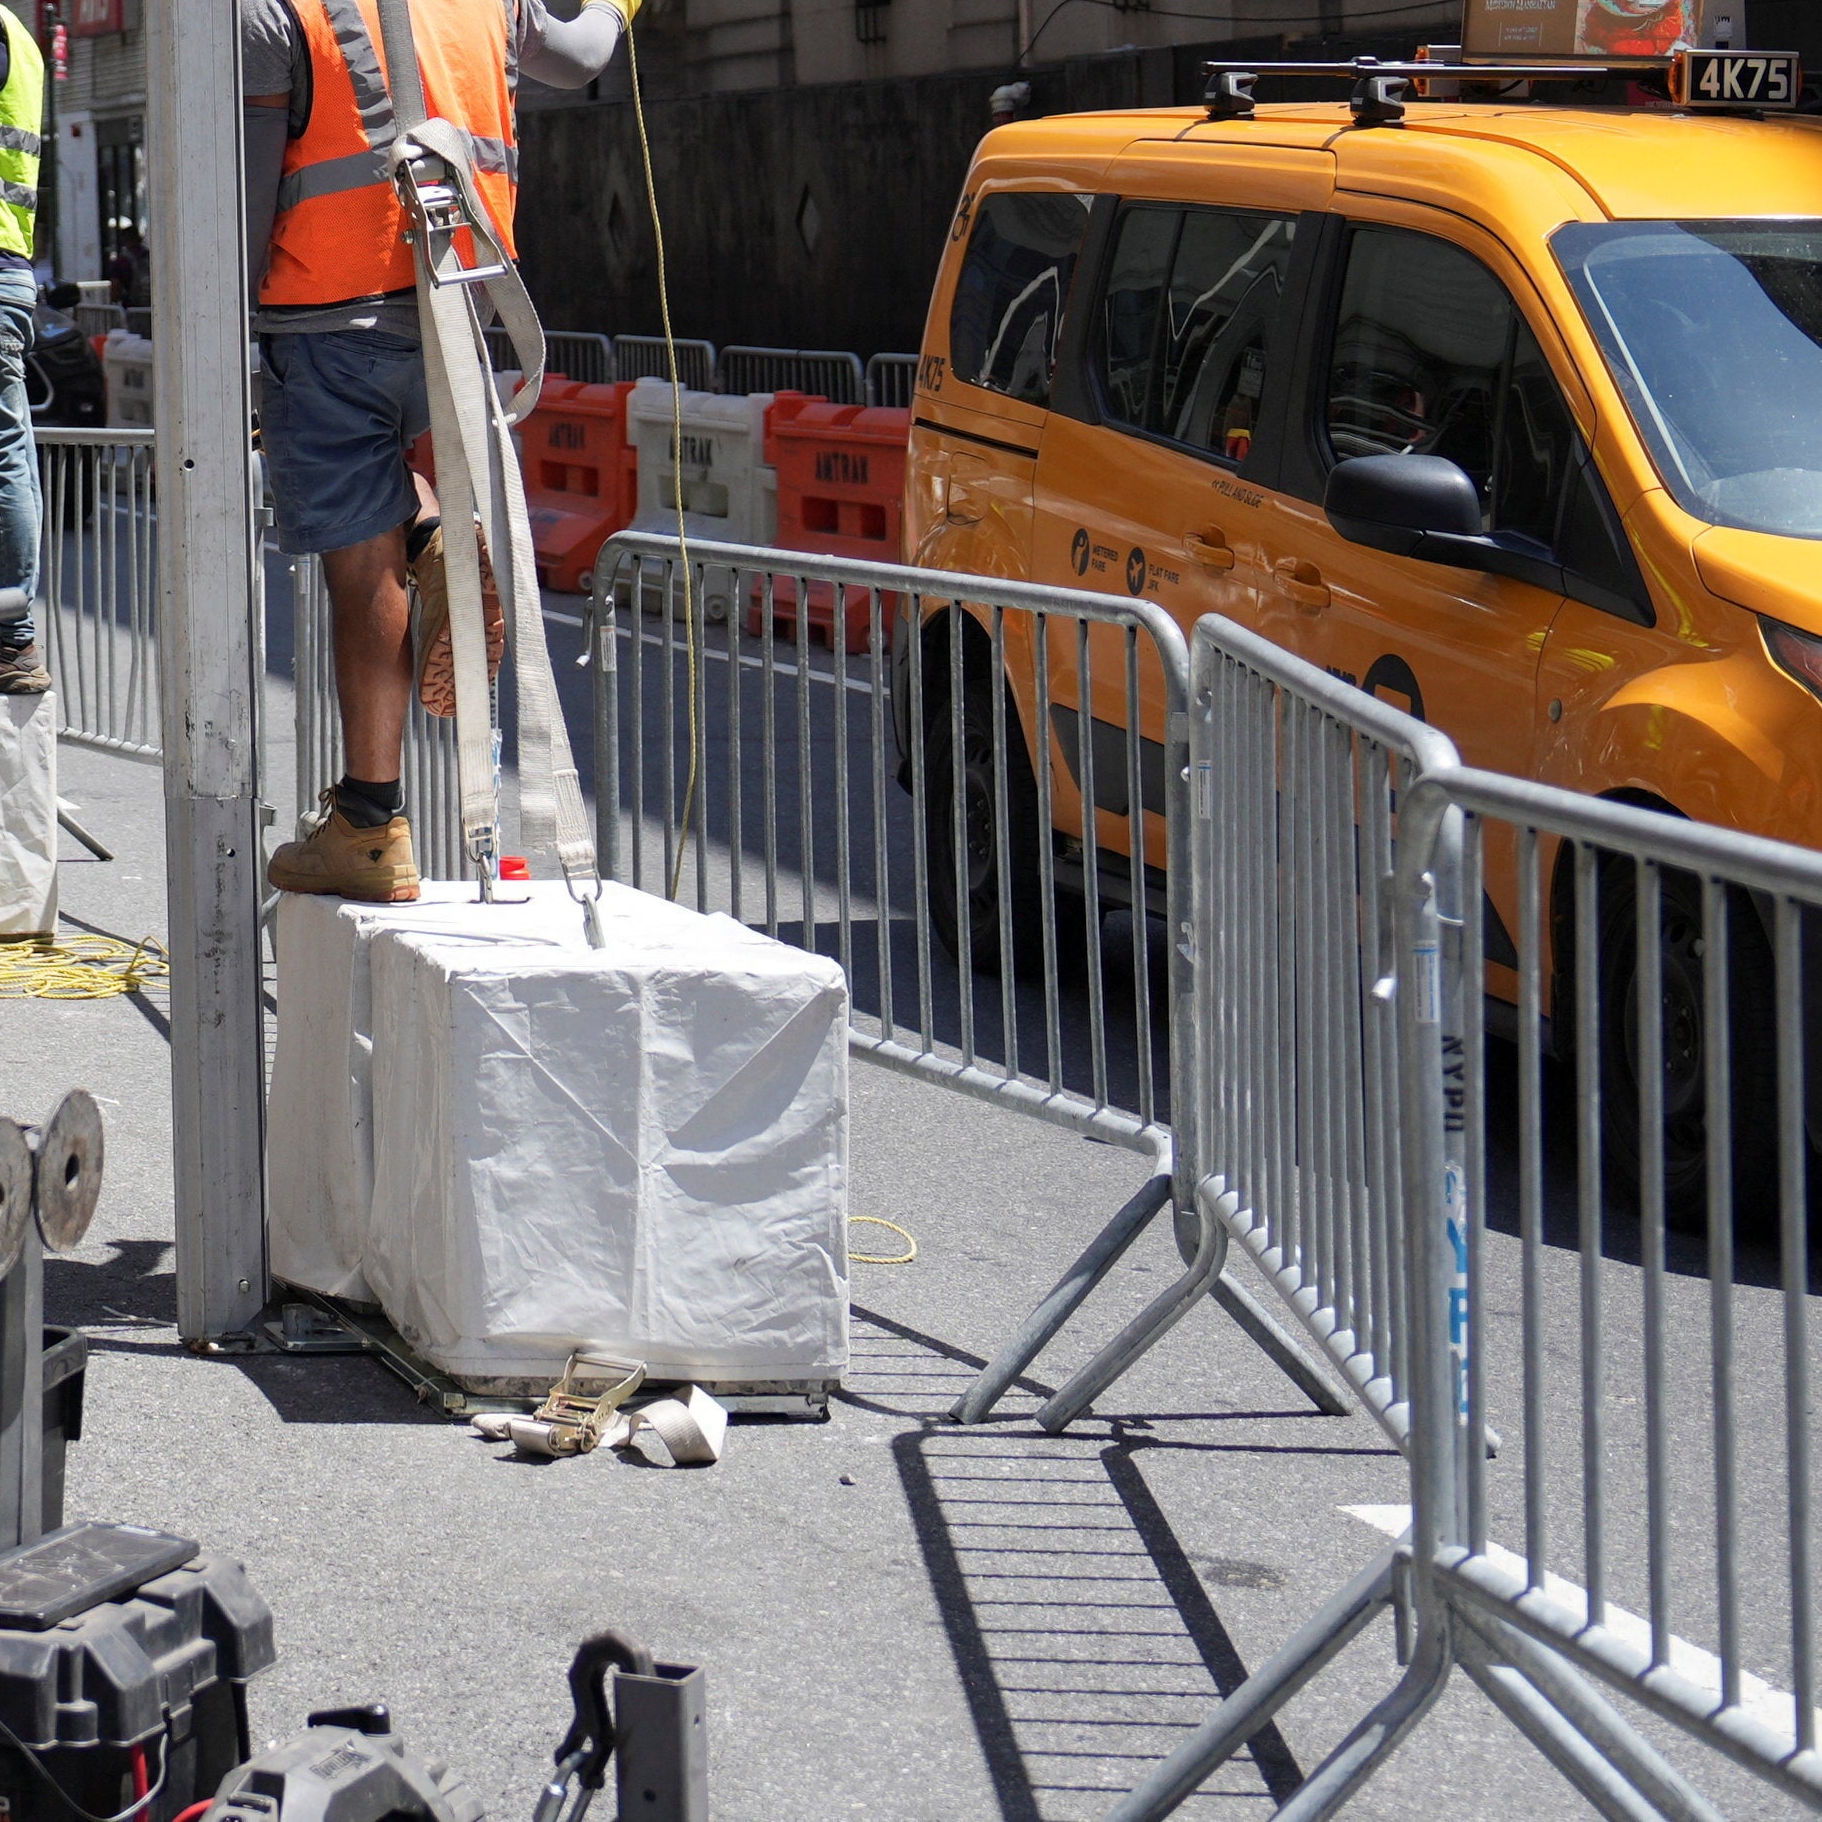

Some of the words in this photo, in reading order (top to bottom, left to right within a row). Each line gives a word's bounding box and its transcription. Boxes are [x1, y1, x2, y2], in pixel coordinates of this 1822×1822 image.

[1699, 58, 1788, 100] 4K75
[815, 451, 869, 485] AMTRAK
[1091, 558, 1107, 573] FARE
[1148, 564, 1164, 578] FLAT
[1163, 569, 1181, 586] FARE
[1147, 579, 1160, 593] JFK
[1441, 1034, 1465, 1133] NYPD
